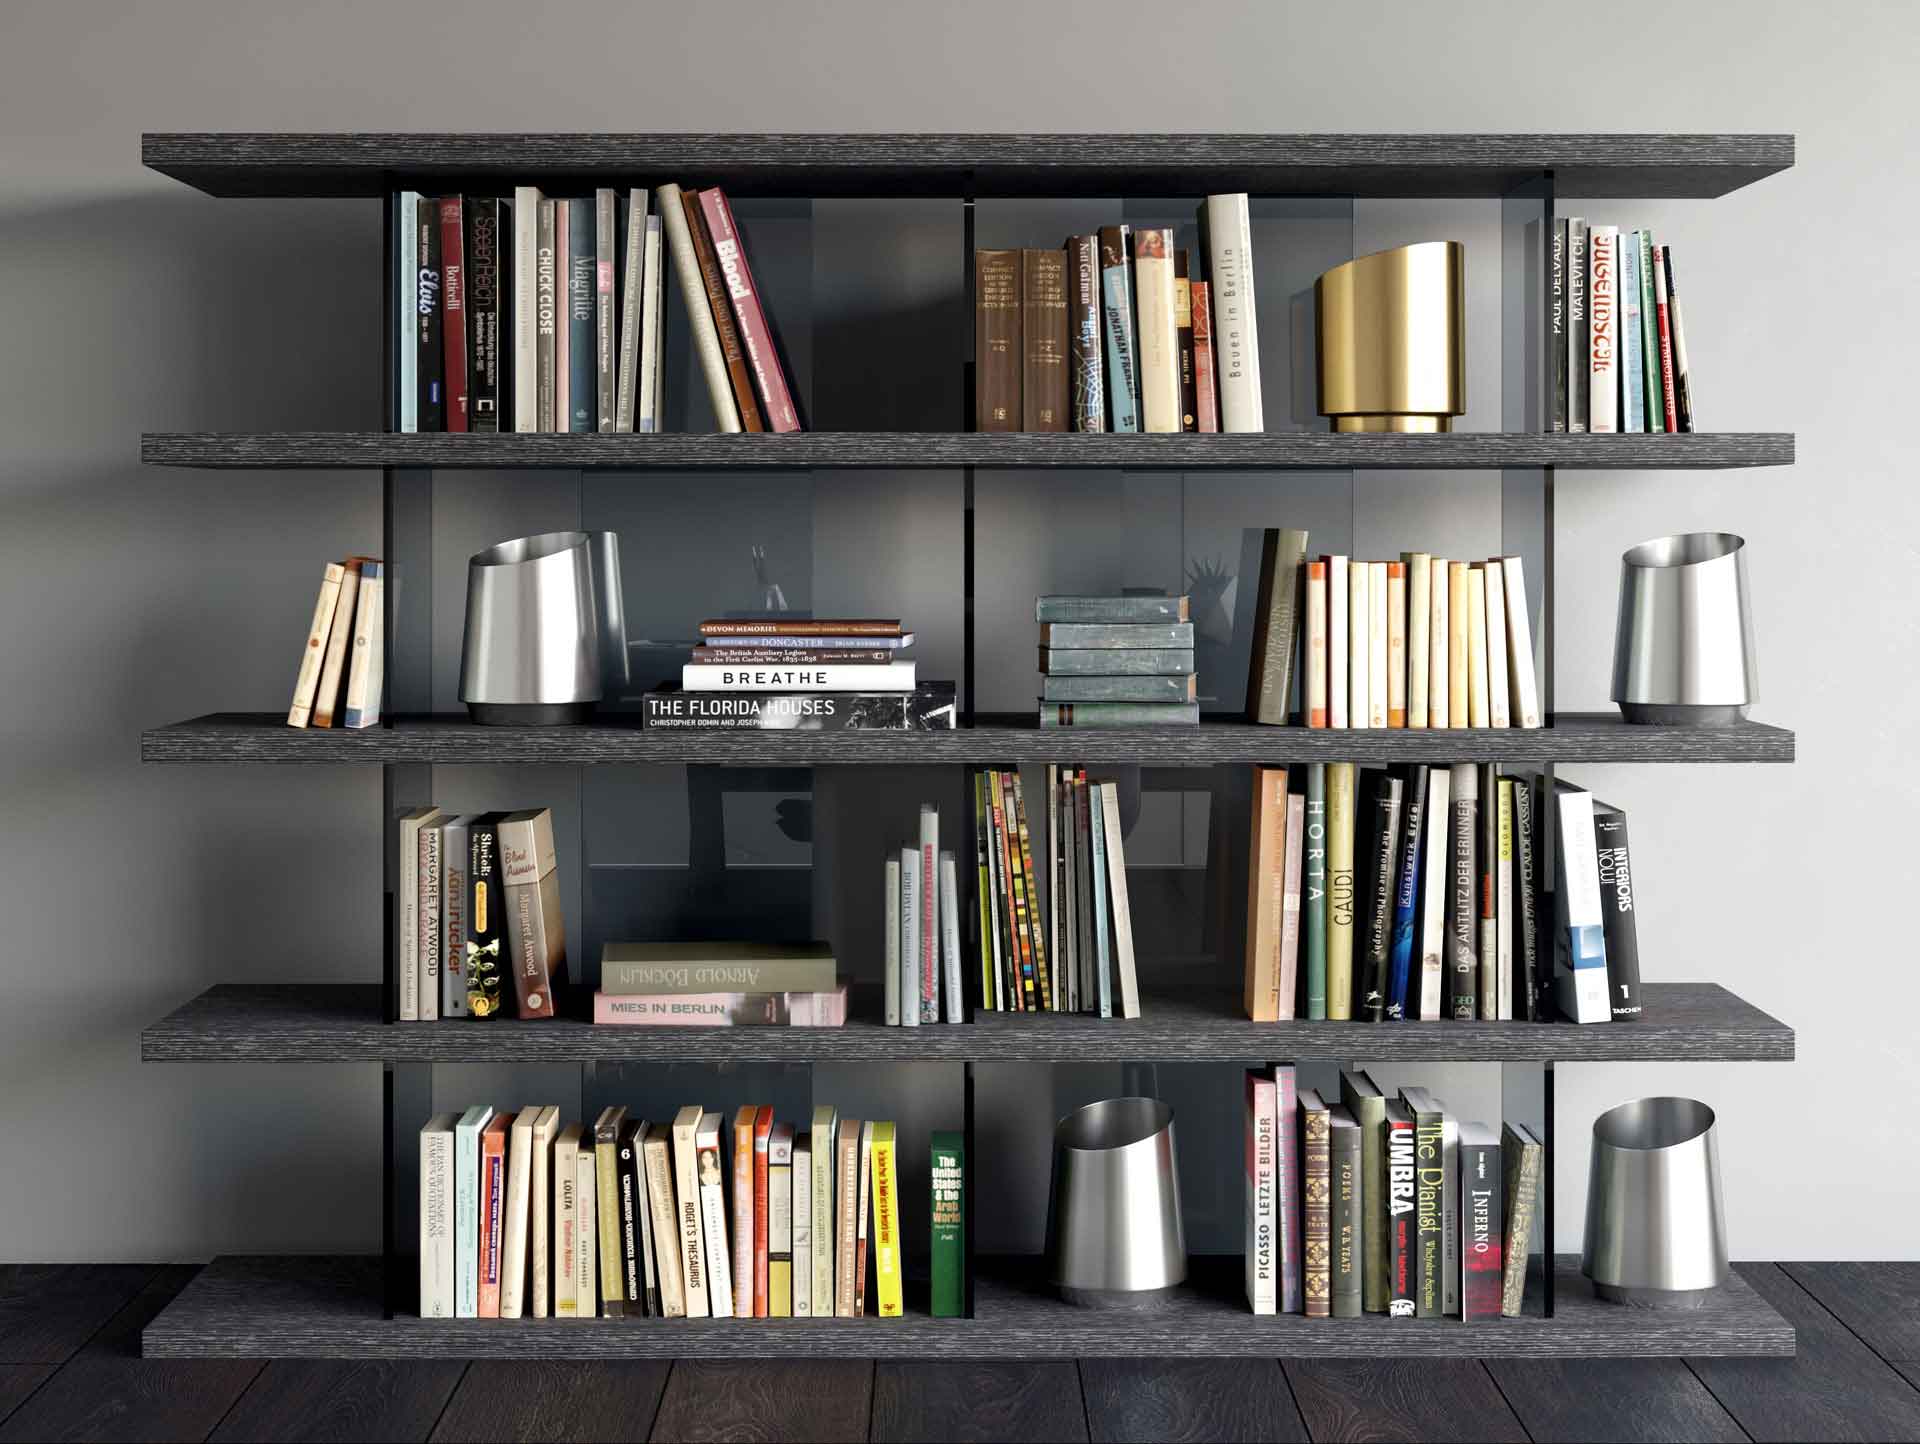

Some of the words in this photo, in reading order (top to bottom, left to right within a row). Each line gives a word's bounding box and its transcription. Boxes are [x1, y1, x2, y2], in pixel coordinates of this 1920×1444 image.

[446, 266, 461, 310] Botticelli
[540, 249, 552, 290] CHUCK
[569, 256, 596, 321] Magritte
[714, 238, 751, 301] Blood
[1220, 248, 1236, 297] Berlin
[1572, 236, 1584, 320] MALEVITCH
[419, 269, 440, 314] Elvis
[540, 294, 553, 335] CLOSE
[1108, 306, 1128, 354] JONATHAN
[1225, 307, 1236, 321] in
[1228, 331, 1242, 378] Bauen
[761, 637, 824, 647] DONCASTER
[722, 671, 828, 685] BREATHE
[650, 699, 683, 716] THE
[688, 699, 761, 716] FLORIDA
[767, 699, 835, 716] HOUSES
[650, 719, 697, 727] CHRISTOPHER
[719, 719, 735, 727] AND
[1381, 830, 1392, 847] The
[1406, 805, 1418, 837] Erde
[428, 832, 438, 911] MARGARET
[479, 833, 493, 877] Shriek:
[1308, 800, 1324, 901] HORTA
[1380, 848, 1391, 884] Promise
[1521, 838, 1533, 881] CLAUDE
[1598, 848, 1615, 885] NOW!
[1379, 886, 1387, 897] of
[1400, 842, 1415, 905] Kunstwerk
[1457, 859, 1470, 885] DER
[1614, 847, 1633, 912] INTERIORS
[519, 893, 532, 936] Margaret
[1373, 898, 1388, 955] Photography
[1457, 888, 1470, 944] ANTLITZ
[428, 917, 438, 977] ATWOOD
[448, 912, 465, 976] rucker
[523, 938, 538, 977] Atwood
[1457, 945, 1470, 973] DAS
[695, 967, 760, 985] ARNOLD
[1620, 985, 1629, 999] 1
[611, 1003, 648, 1013] MIES
[652, 1003, 667, 1013] IN
[671, 1004, 725, 1014] BERLIN
[621, 1148, 631, 1160] 6
[938, 1156, 955, 1167] The
[1259, 1117, 1270, 1165] BILDER
[1417, 1122, 1443, 1159] The
[1259, 1170, 1270, 1216] LETZTE
[1341, 1164, 1351, 1200] POEMS
[1390, 1128, 1414, 1216] UMBRA
[563, 1179, 573, 1210] LOLITA
[944, 1190, 959, 1201] the
[1417, 1167, 1443, 1236] Pianist
[684, 1202, 697, 1236] ROGET'S
[1471, 1189, 1491, 1253] INFERNO
[686, 1240, 701, 1288] THESAURUS
[1259, 1225, 1271, 1280] PICASSO
[1341, 1246, 1352, 1274] YEATS
